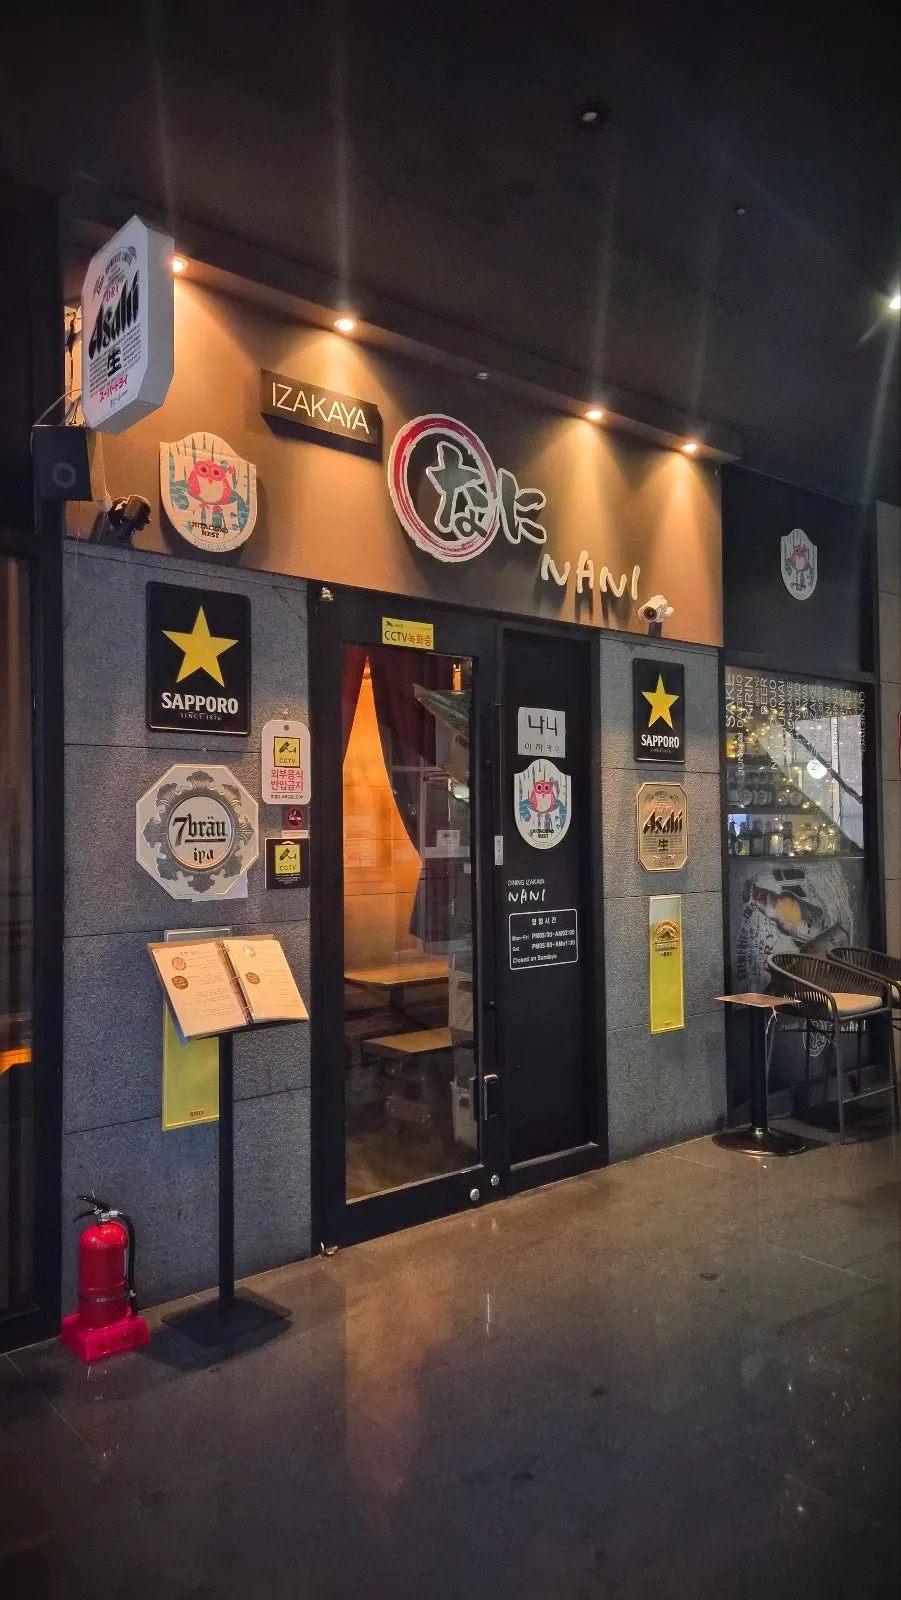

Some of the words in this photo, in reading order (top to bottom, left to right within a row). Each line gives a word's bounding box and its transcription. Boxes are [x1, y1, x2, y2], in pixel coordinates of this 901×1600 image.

[88, 270, 140, 360] Asahi
[107, 349, 122, 378] 生
[271, 382, 370, 434] IZAKAYA
[541, 550, 641, 600] NANI
[161, 692, 239, 715] SAPPORO
[725, 673, 736, 728] SAKE
[744, 676, 754, 720] KIRIN
[760, 677, 768, 715] BEER
[641, 734, 680, 749] SAPPORO
[270, 769, 304, 781] 외부음식
[270, 780, 304, 791] 반입금지
[643, 809, 683, 835] Asahi
[193, 848, 214, 864] ipa
[658, 838, 670, 851] 生
[280, 864, 297, 872] CCTV
[508, 888, 546, 904] NANI
